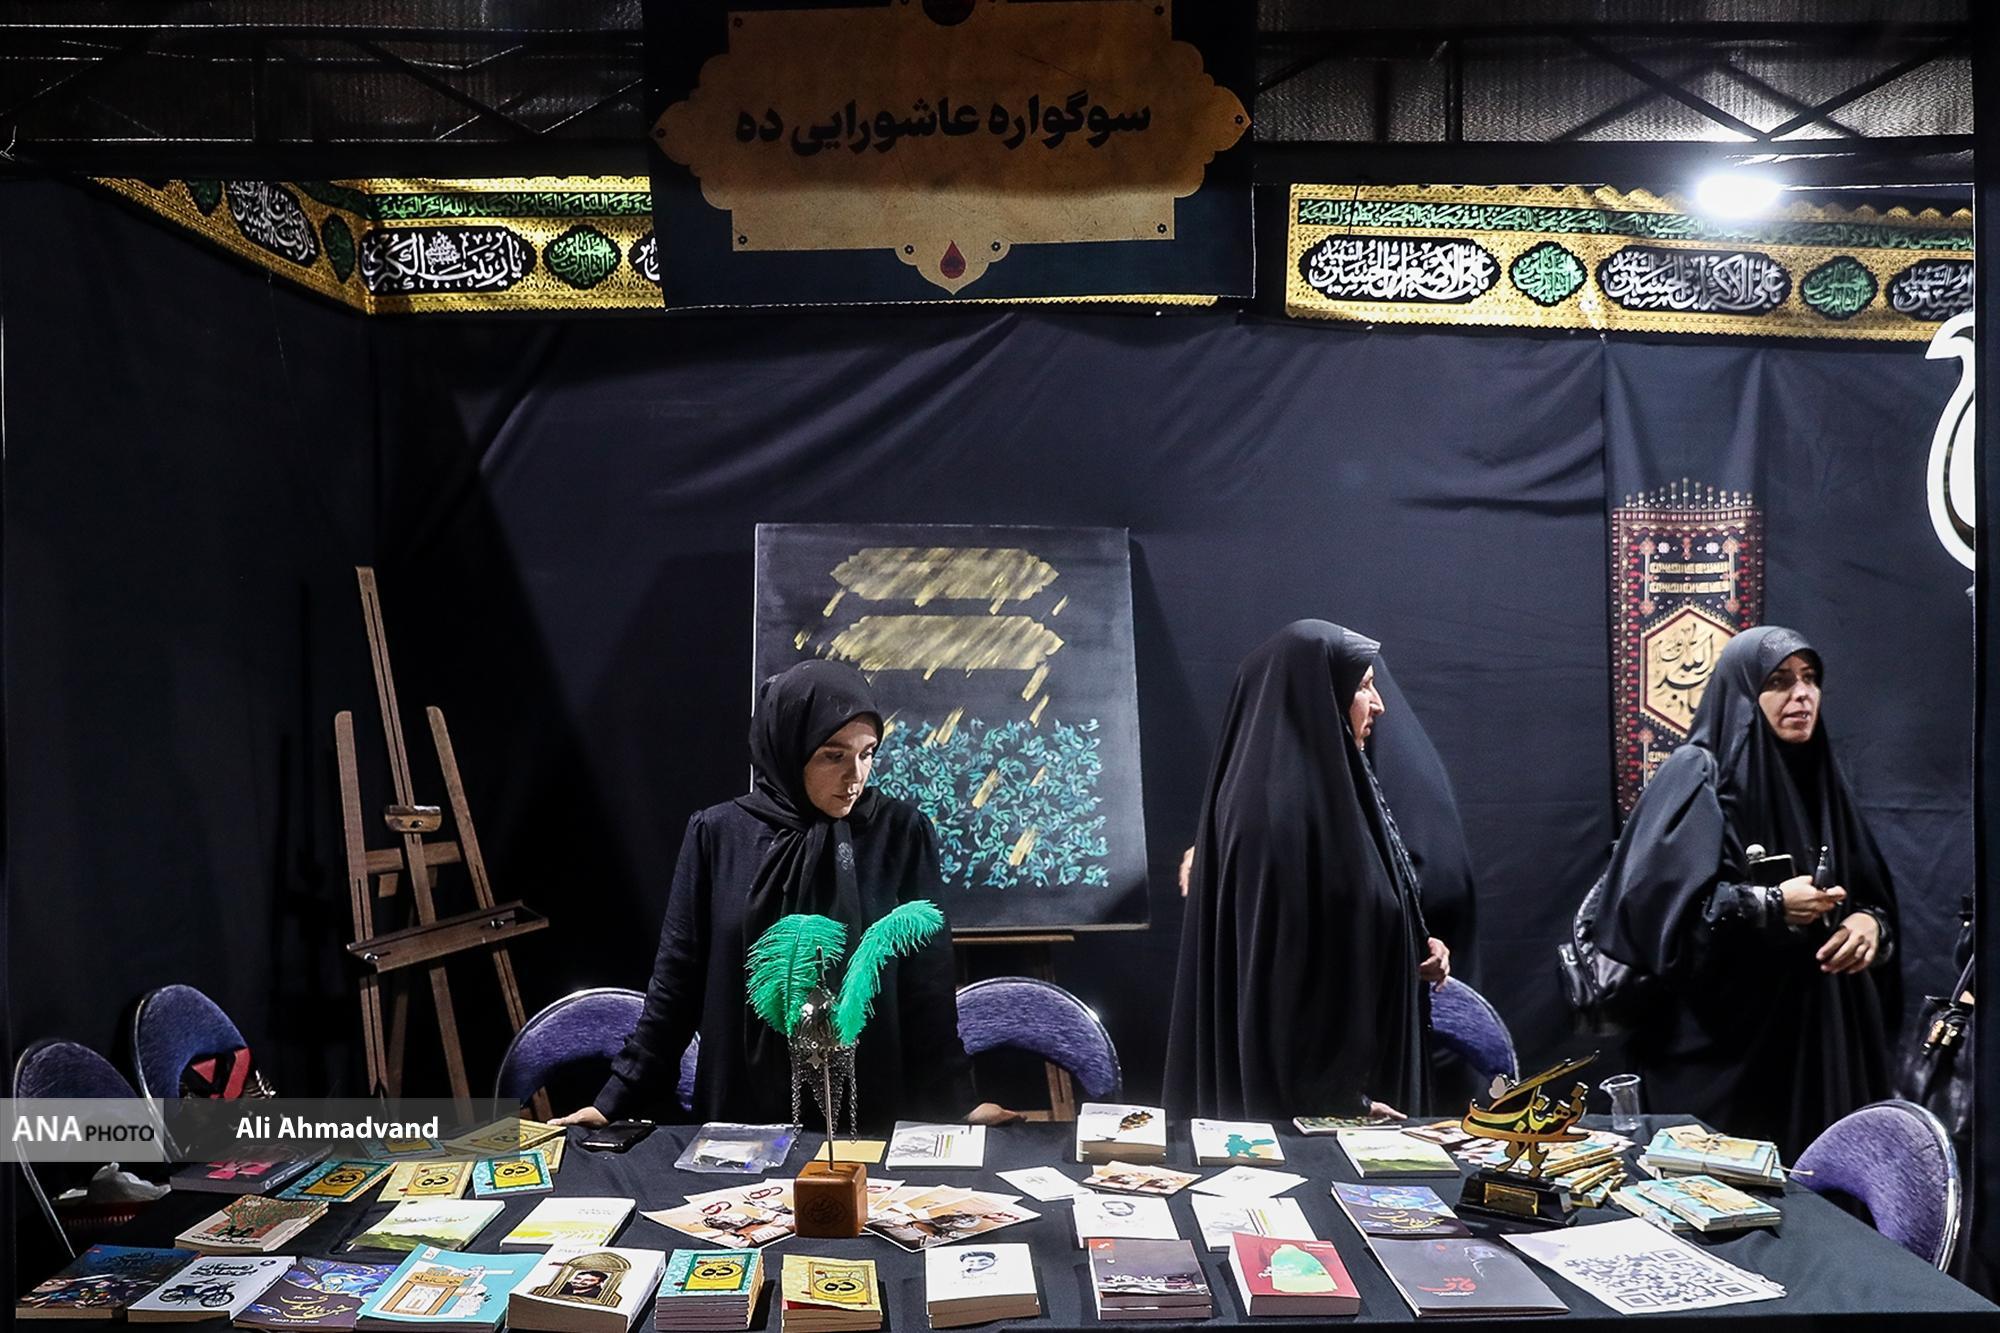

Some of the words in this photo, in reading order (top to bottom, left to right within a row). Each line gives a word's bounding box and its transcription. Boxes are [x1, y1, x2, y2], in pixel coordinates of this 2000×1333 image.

[735, 106, 782, 143] ده
[791, 97, 979, 156] عاشورایی
[988, 89, 1151, 149] سوگواره
